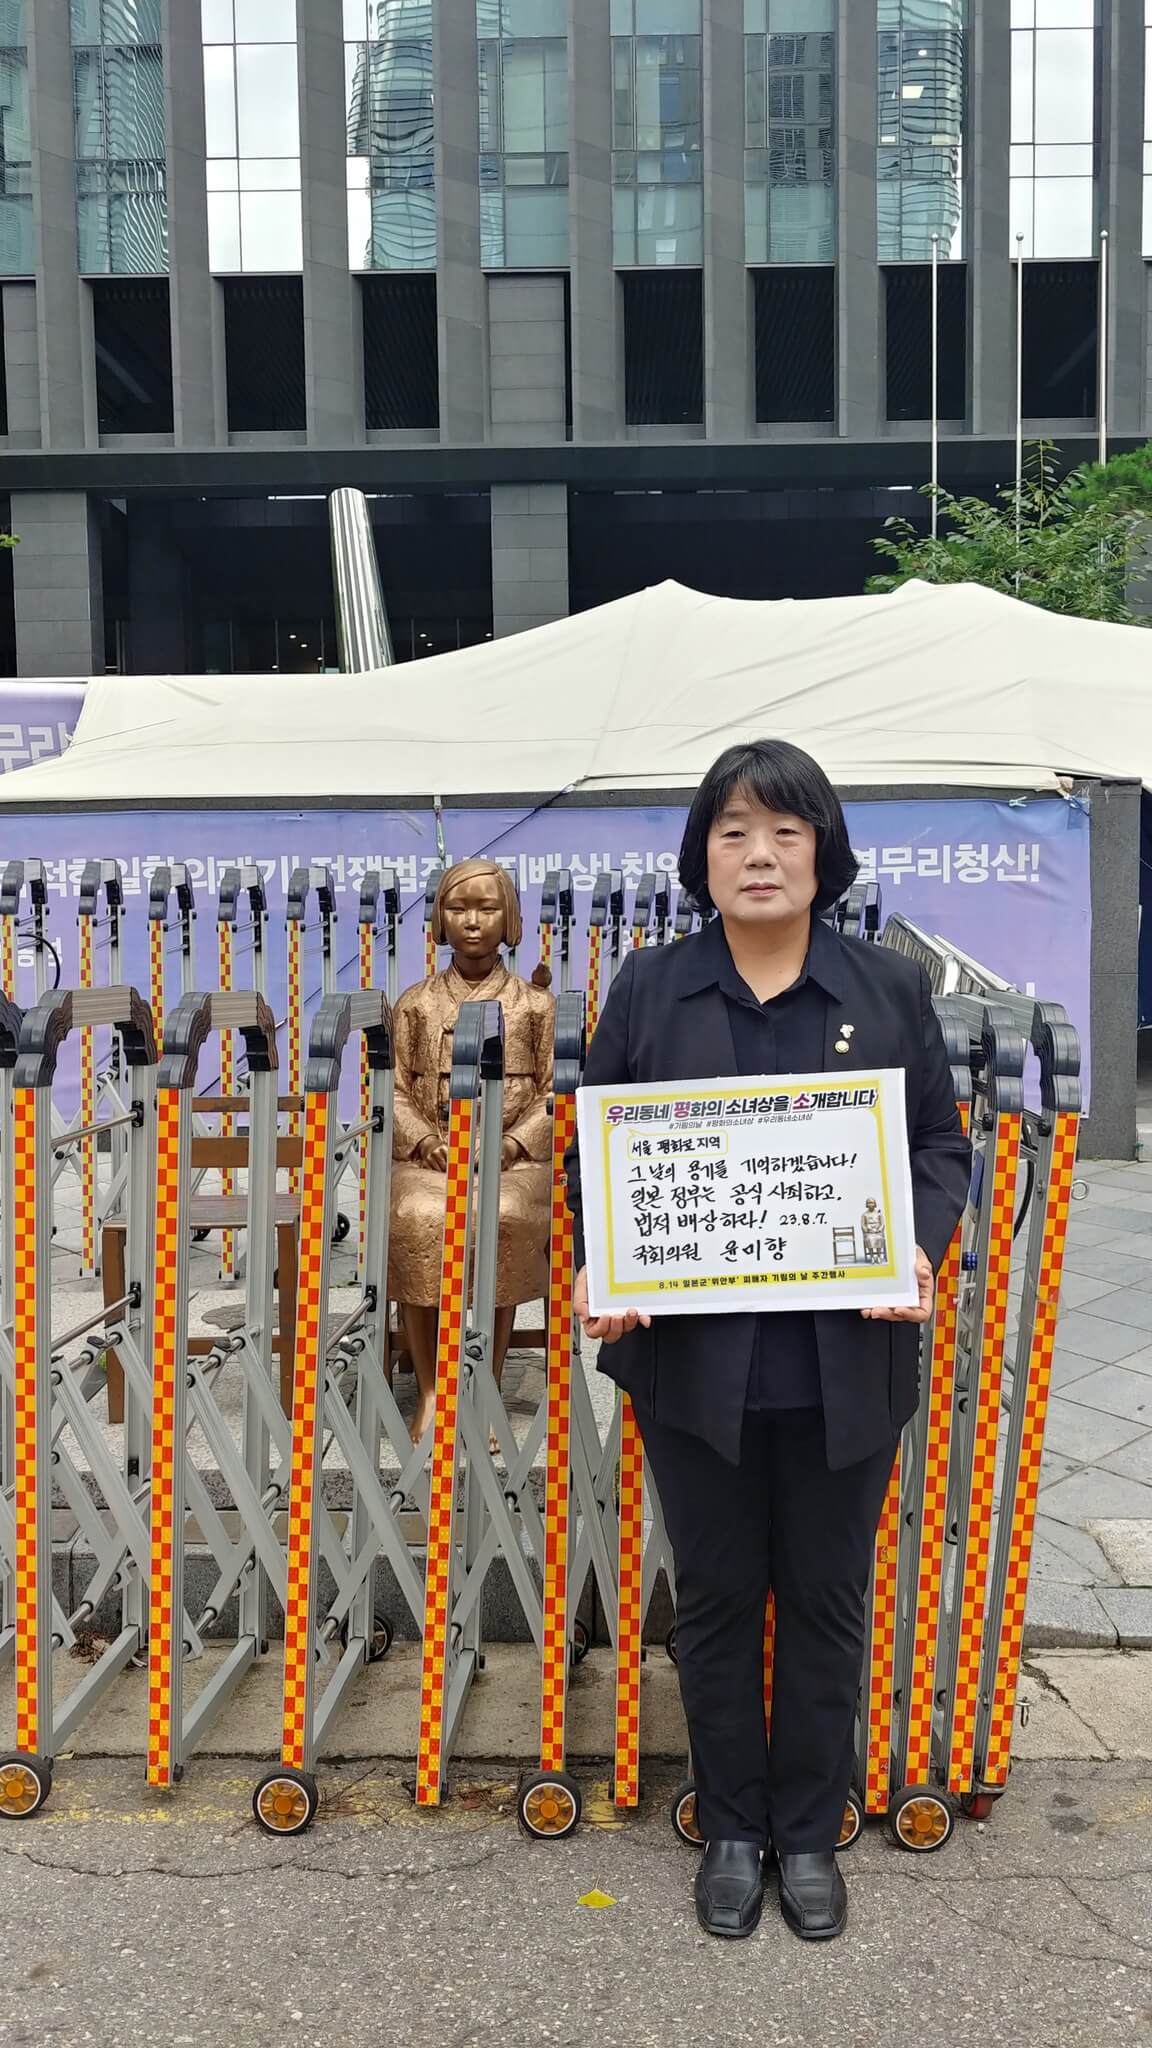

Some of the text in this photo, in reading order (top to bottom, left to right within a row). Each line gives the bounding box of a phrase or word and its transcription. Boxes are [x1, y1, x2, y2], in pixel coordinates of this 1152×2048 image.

[607, 1089, 877, 1123] 우리동네 평화의 소녀상을 소개합니다
[706, 1117, 754, 1127] #평화의소녀상
[757, 1113, 813, 1123] #우리동네소녀상
[631, 1136, 721, 1157] 서울 평화로 지역
[627, 1153, 857, 1183] 그 날의 용기를 기억하겠습니다!
[630, 1185, 664, 1211] 일본
[671, 1185, 715, 1209] 정부는
[730, 1182, 762, 1206] 공식
[634, 1212, 670, 1238] 법적
[779, 1213, 828, 1226] 23.8.7.
[632, 1236, 787, 1266] 국회의원 윤미향
[659, 1281, 679, 1289] 8.14
[743, 1274, 768, 1283] 피해자
[772, 1273, 797, 1281] 기림의
[800, 1272, 808, 1280] 날
[812, 1270, 846, 1279] 주간행사
